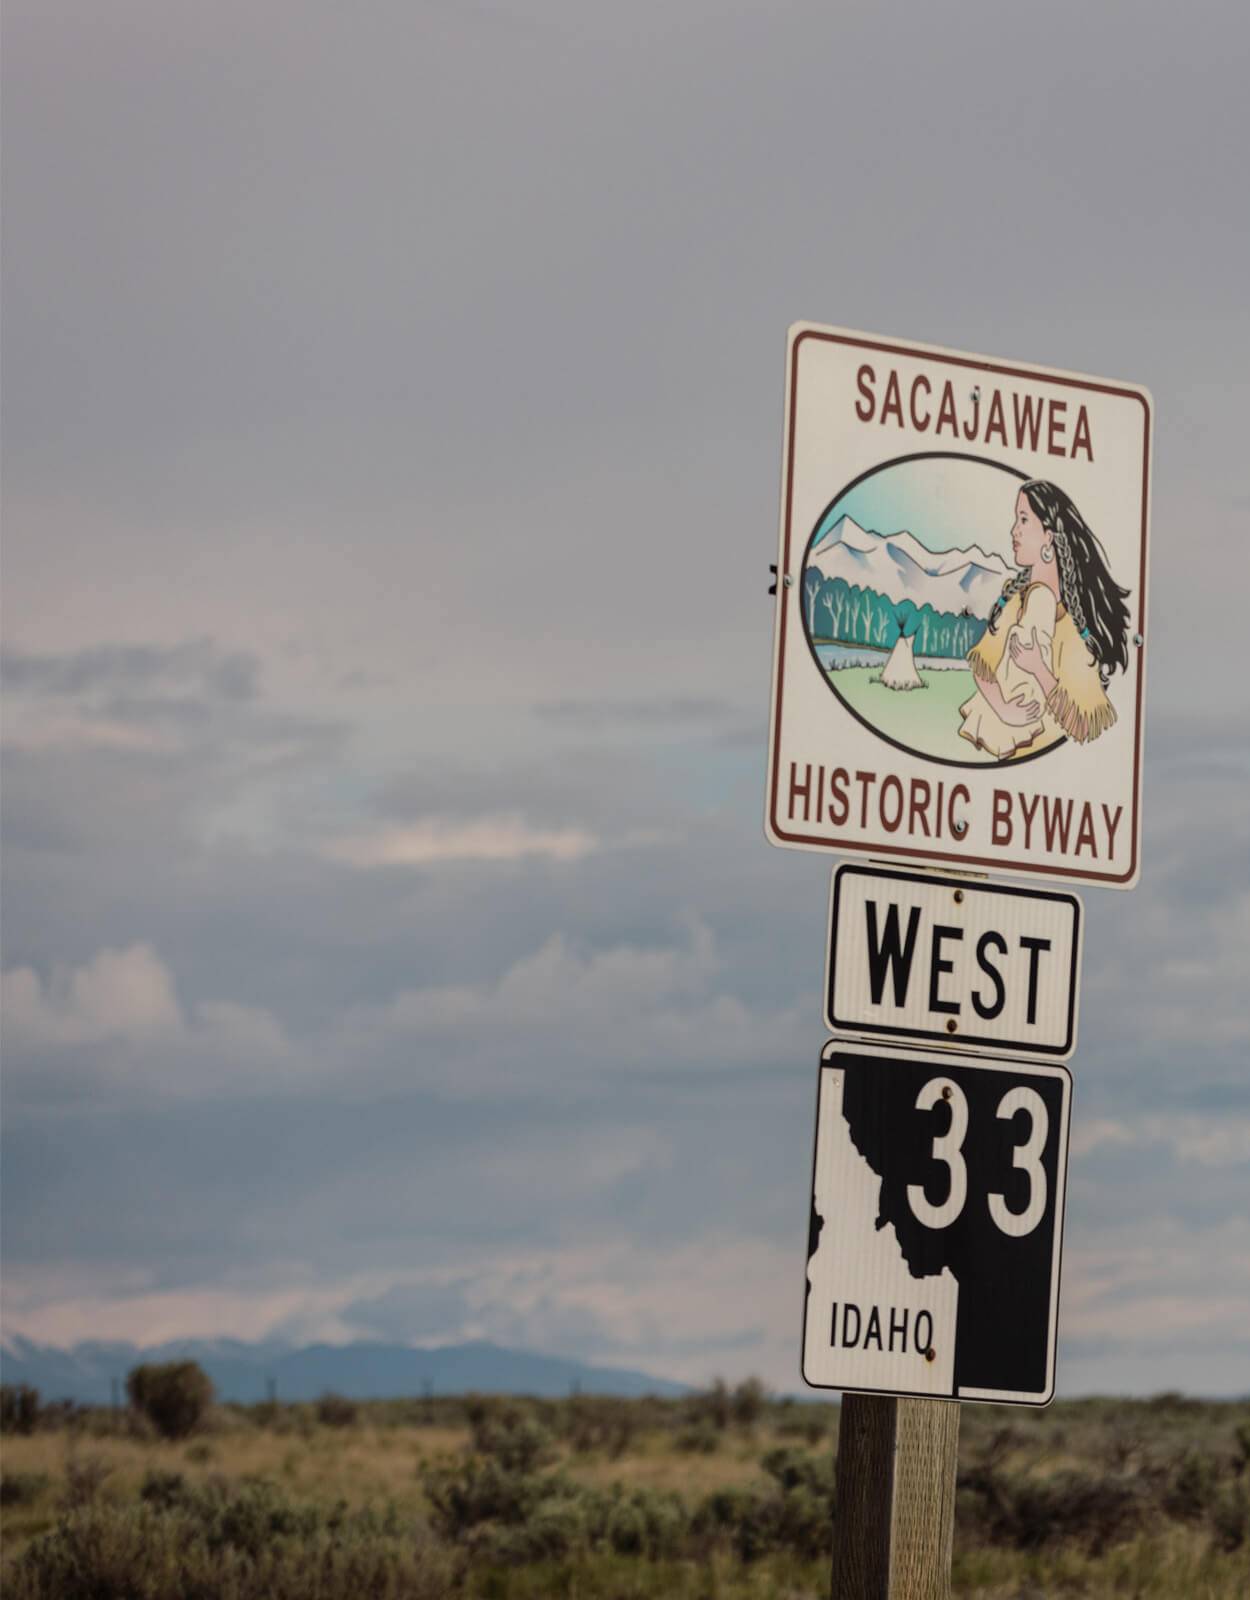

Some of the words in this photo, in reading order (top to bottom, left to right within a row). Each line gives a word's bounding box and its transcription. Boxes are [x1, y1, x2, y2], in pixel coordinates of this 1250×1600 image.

[855, 364, 1094, 462] SACAJAWEA
[787, 762, 970, 842] HISTORIC
[991, 788, 1123, 861] BYWAY
[865, 900, 1052, 1025] WEST
[906, 1076, 1049, 1237] 33
[830, 1302, 934, 1355] IDAHO
